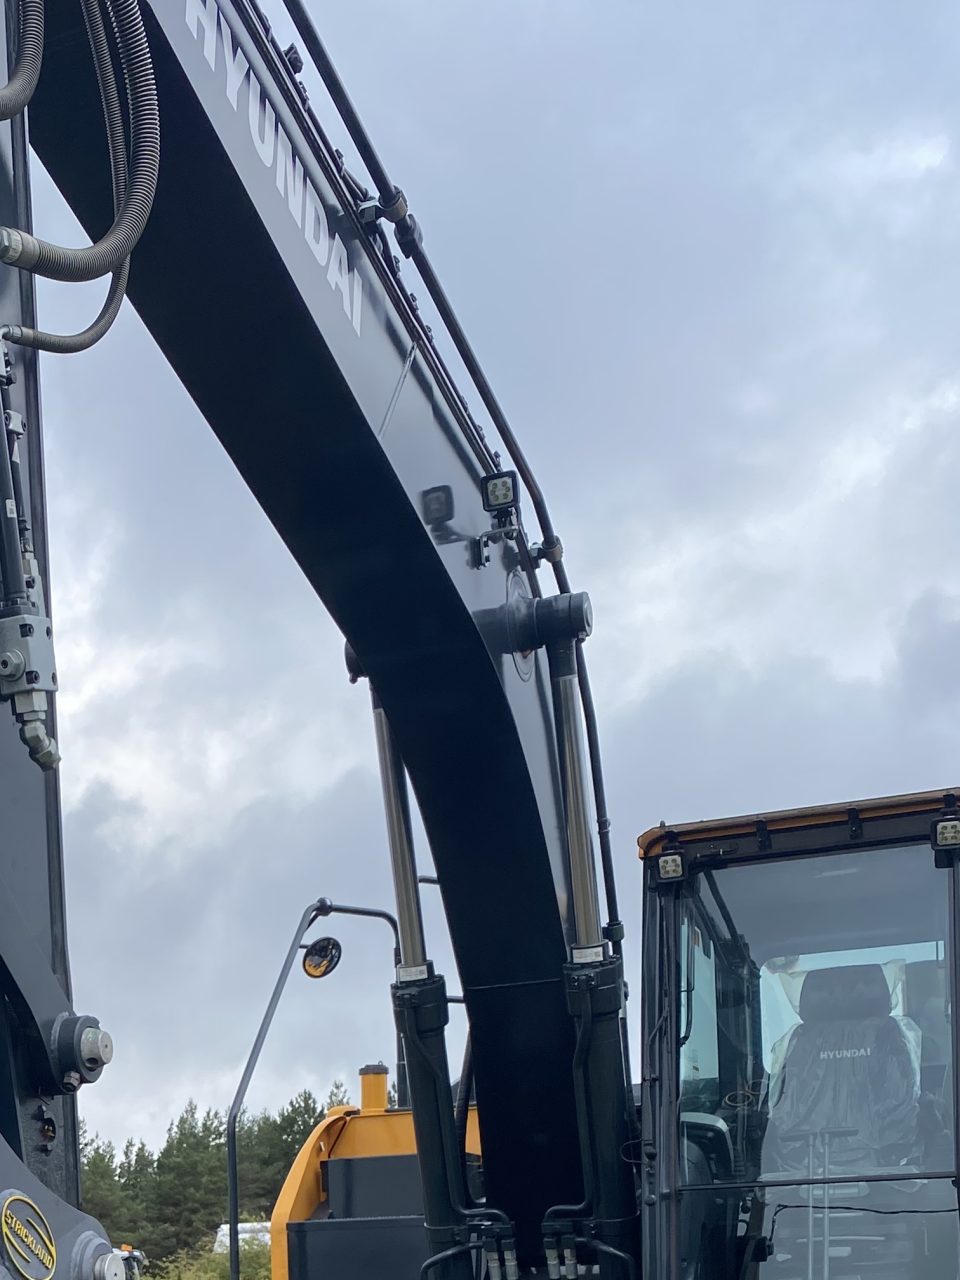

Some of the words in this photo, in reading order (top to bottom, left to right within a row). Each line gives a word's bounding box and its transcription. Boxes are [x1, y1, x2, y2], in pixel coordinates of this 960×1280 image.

[185, 0, 363, 337] HYUNDAI
[820, 1048, 871, 1060] HYUNDAI
[5, 1209, 53, 1269] STRICKLAND
